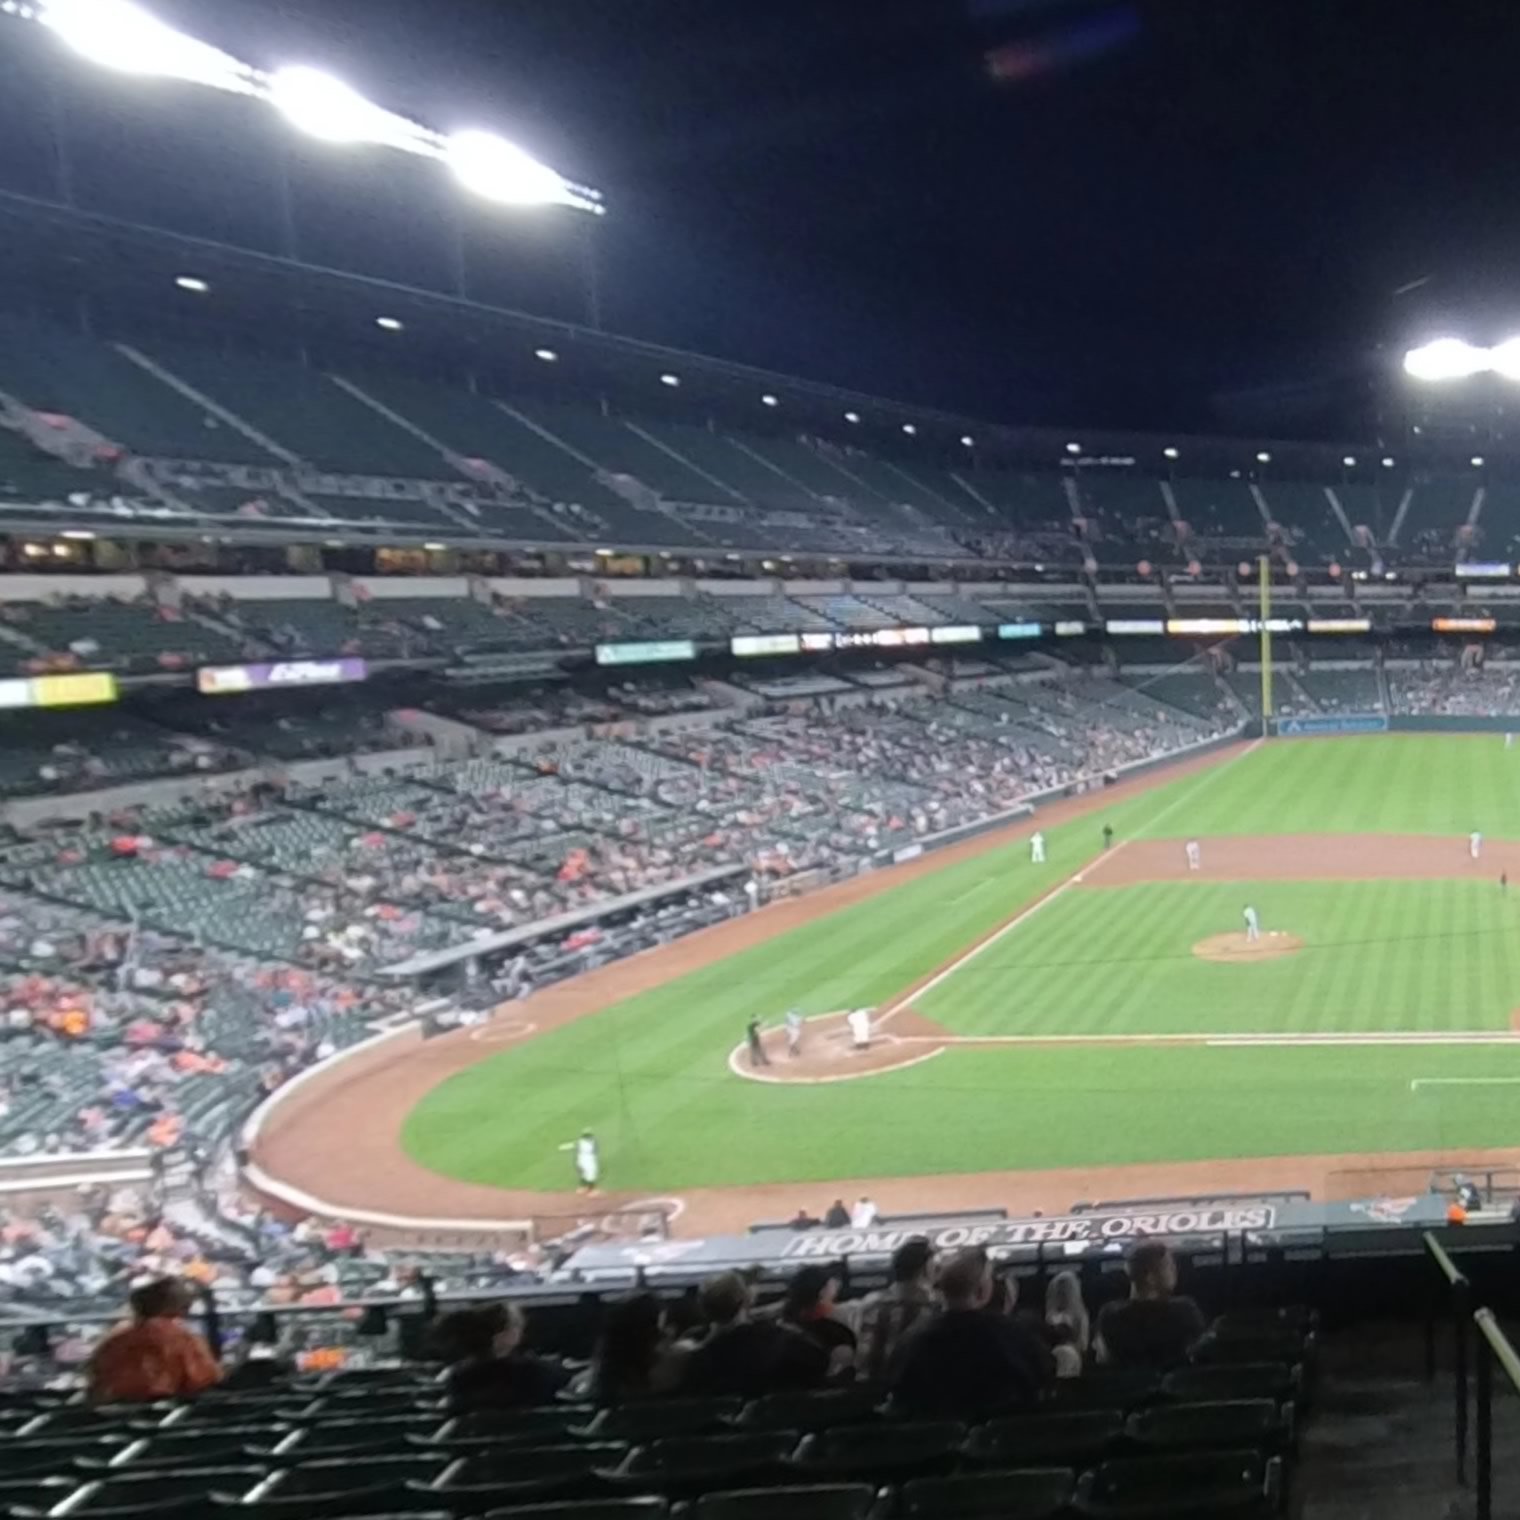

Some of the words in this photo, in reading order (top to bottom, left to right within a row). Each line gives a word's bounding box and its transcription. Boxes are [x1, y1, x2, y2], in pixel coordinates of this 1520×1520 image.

[791, 1231, 927, 1257] HOM
[935, 1226, 998, 1248] OF
[1005, 1221, 1097, 1243] THE
[1101, 1208, 1266, 1237] ORIOLES
